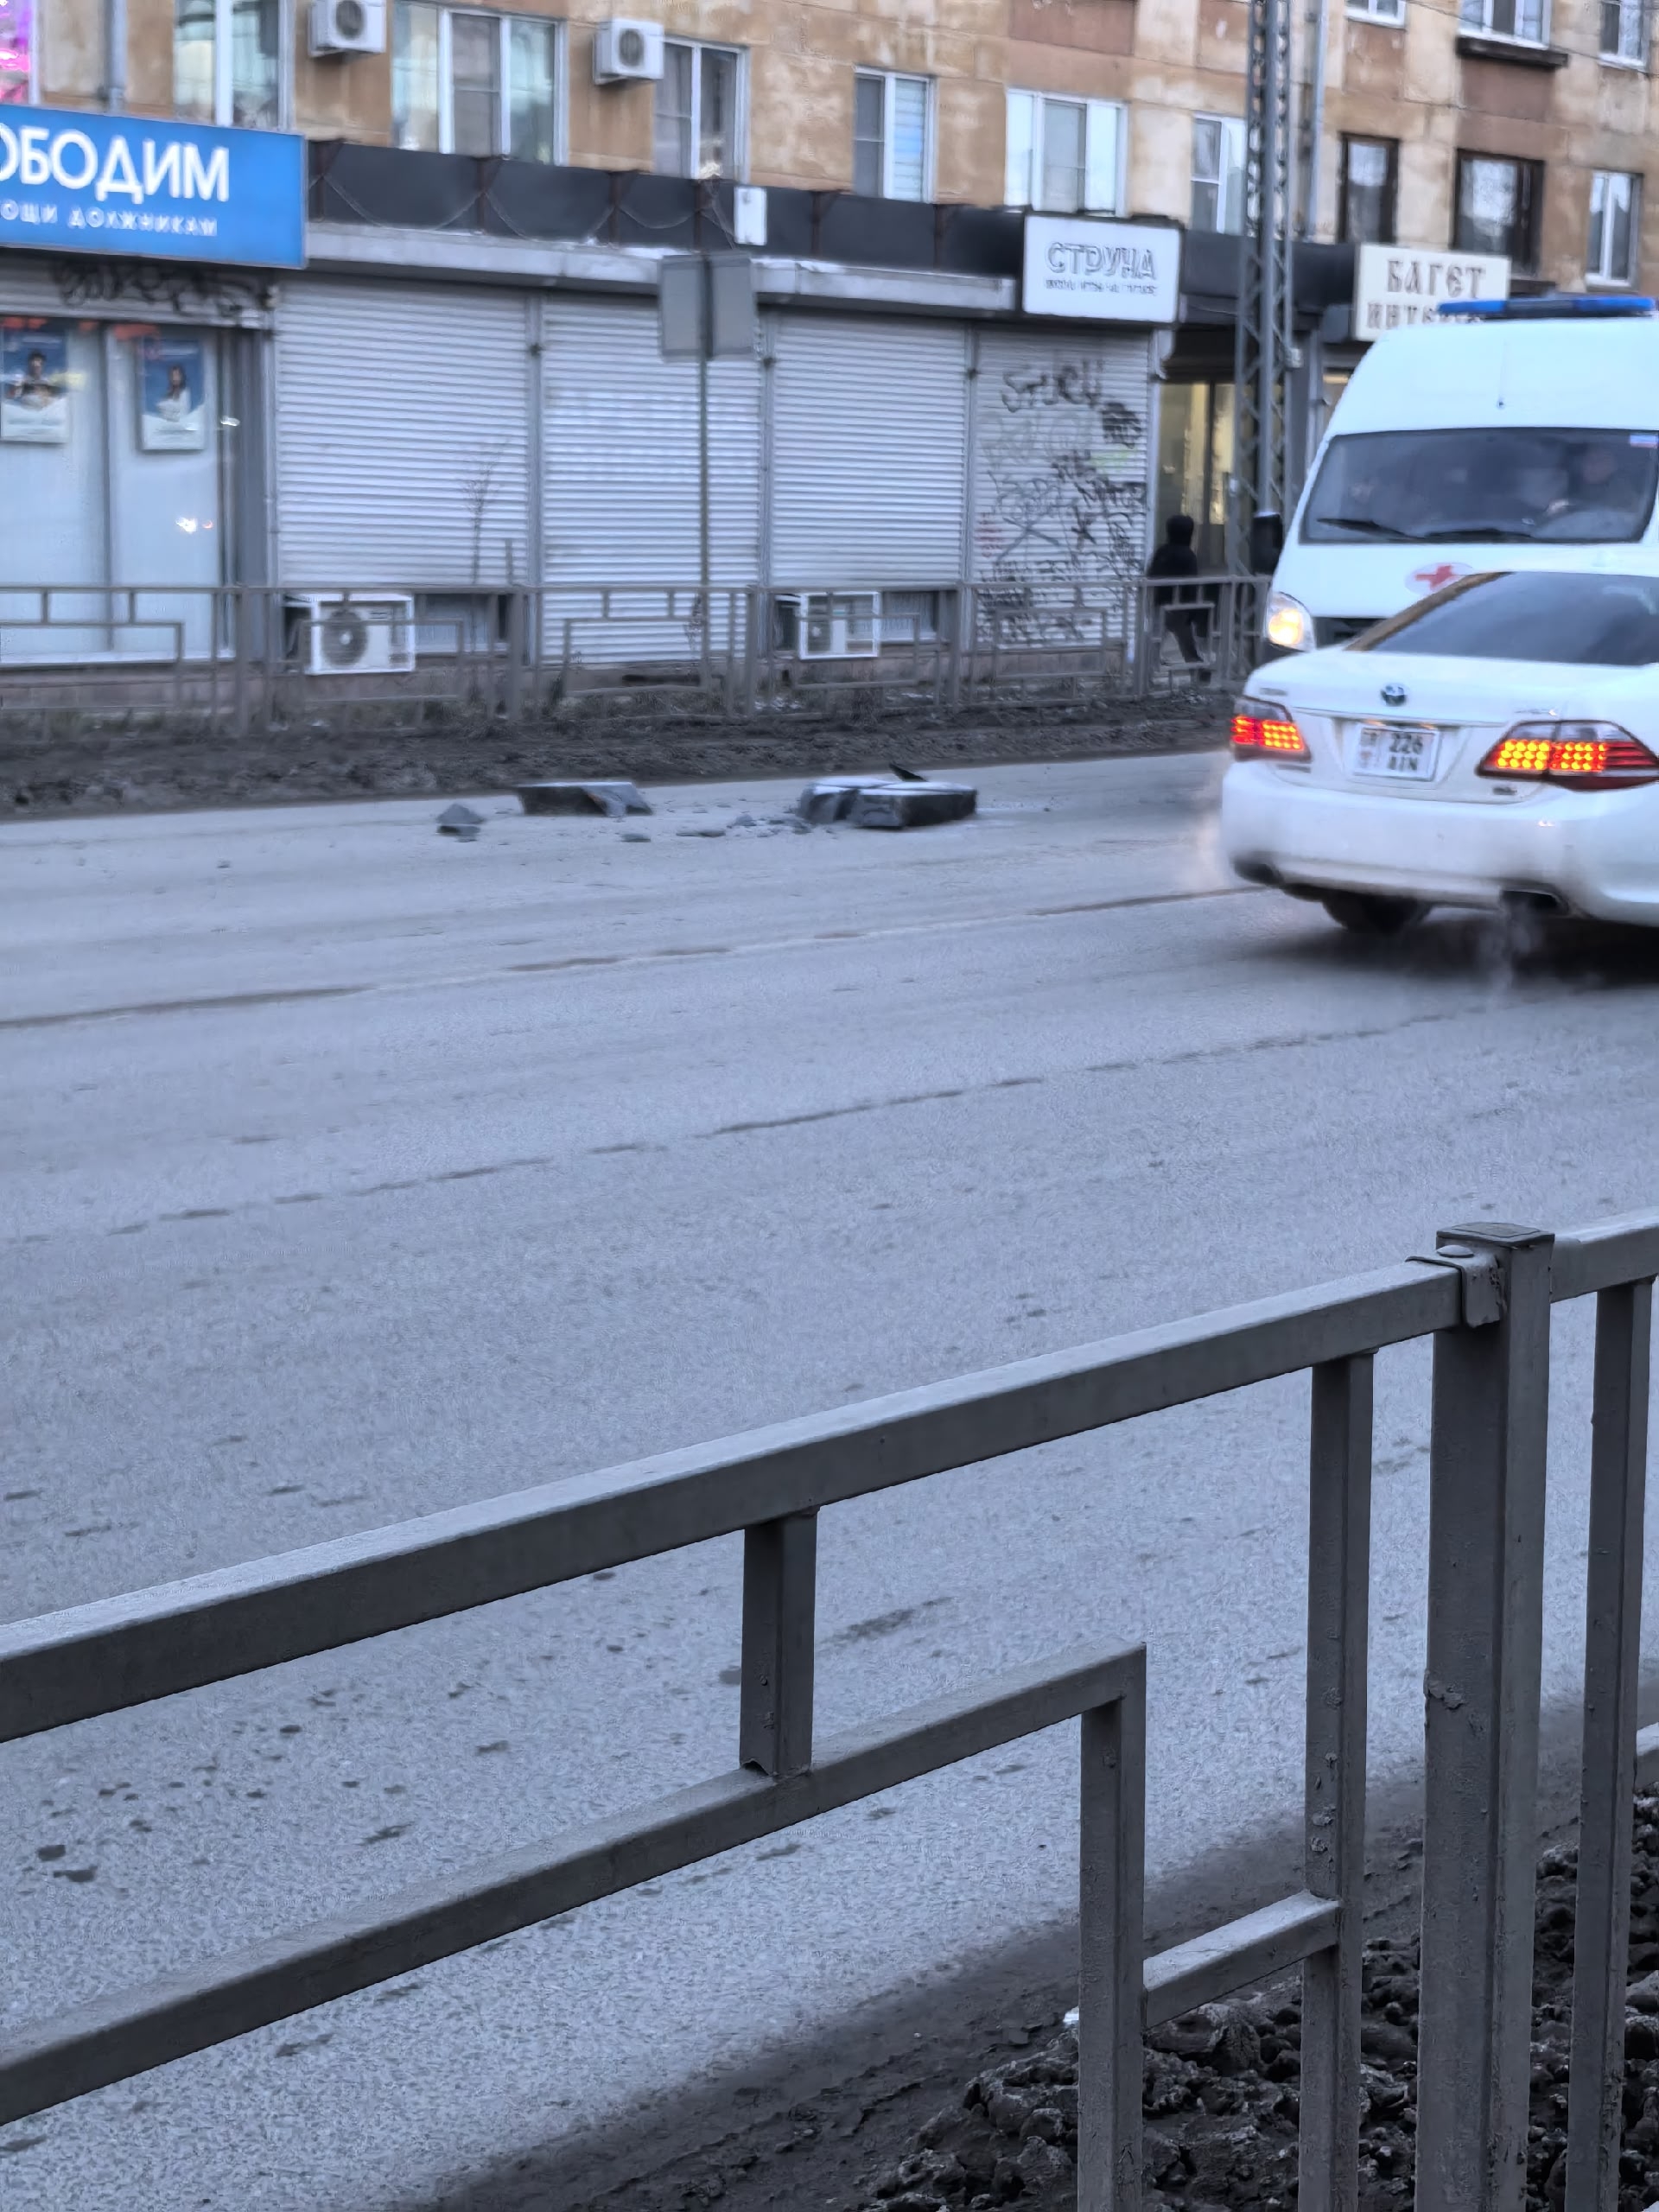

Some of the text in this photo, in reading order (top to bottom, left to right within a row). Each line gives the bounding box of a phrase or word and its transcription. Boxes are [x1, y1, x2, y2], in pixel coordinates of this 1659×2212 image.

[68, 207, 218, 237] ДОЛЖНИКАМ
[1046, 241, 1156, 280] СТРУНА
[1386, 259, 1487, 299] БАГЕТ
